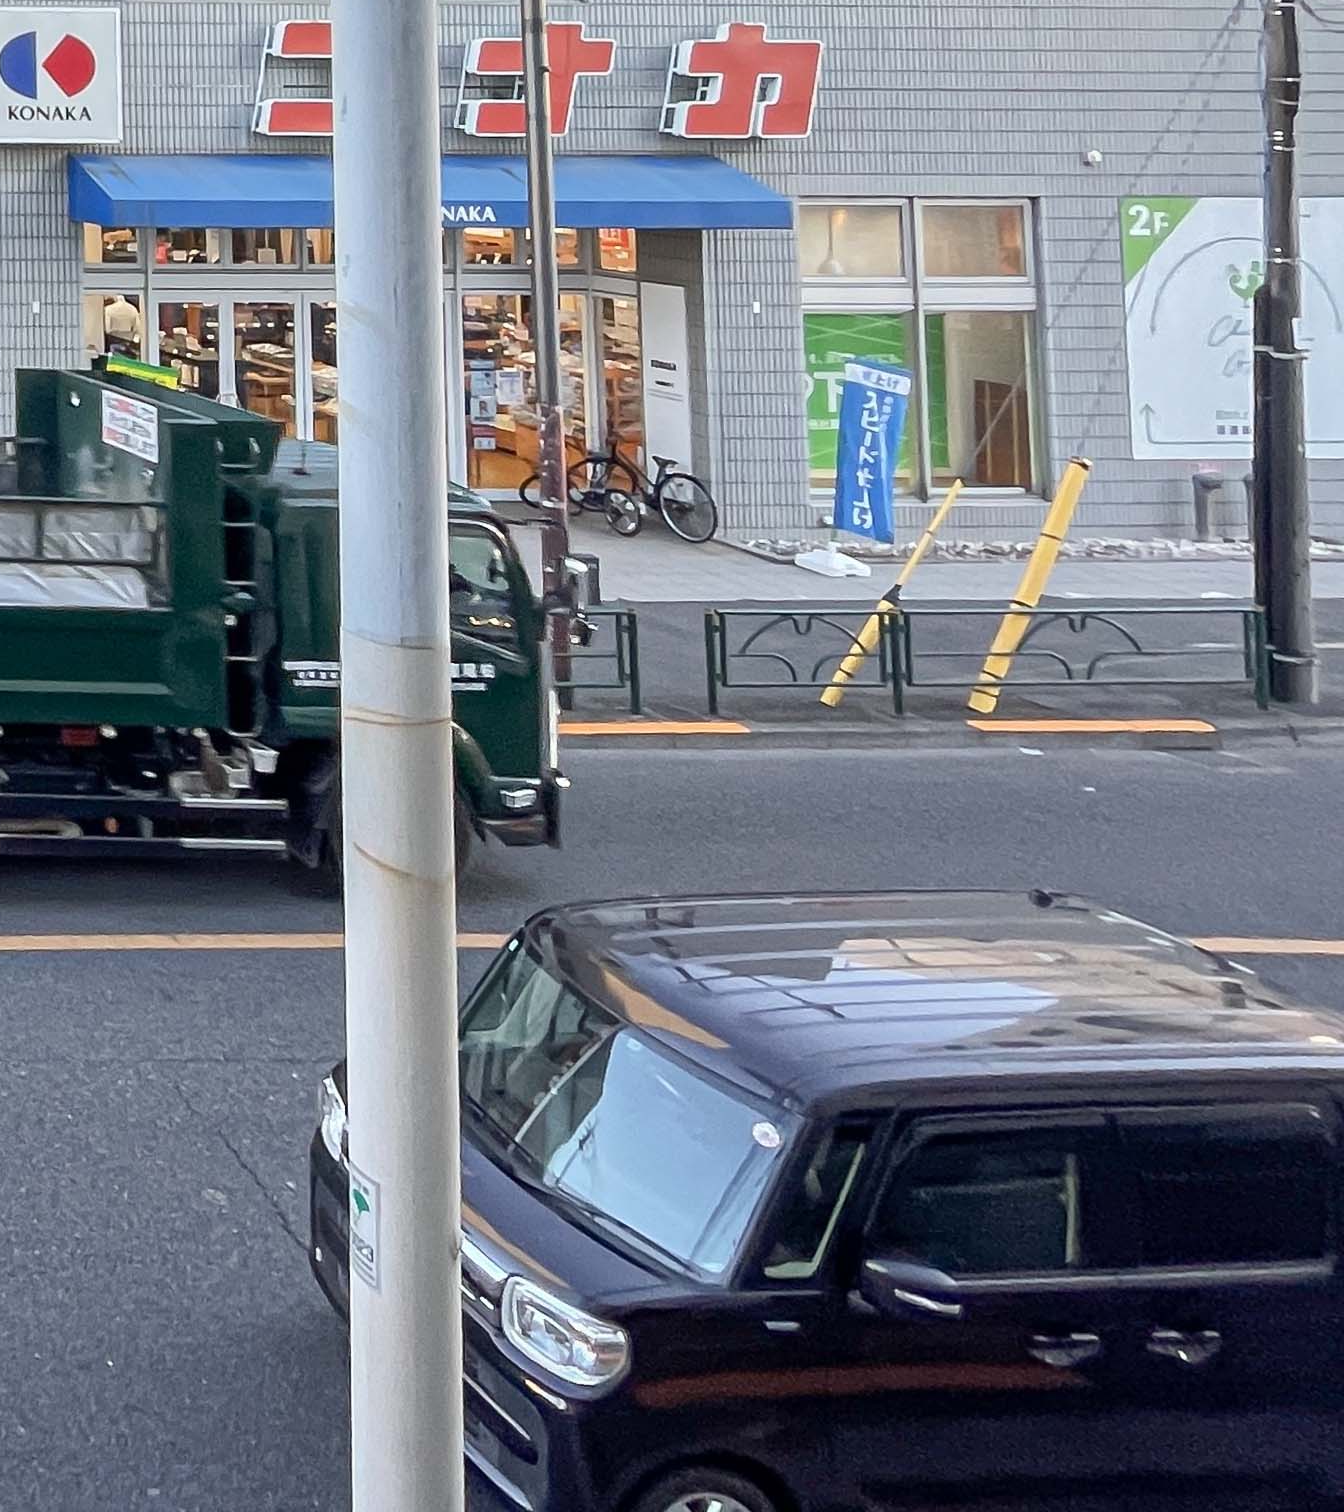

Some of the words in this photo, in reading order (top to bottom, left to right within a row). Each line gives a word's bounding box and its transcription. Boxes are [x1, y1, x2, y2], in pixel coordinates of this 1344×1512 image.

[7, 105, 92, 121] KONAKA
[441, 205, 496, 222] NAKA
[1128, 204, 1169, 236] 2F
